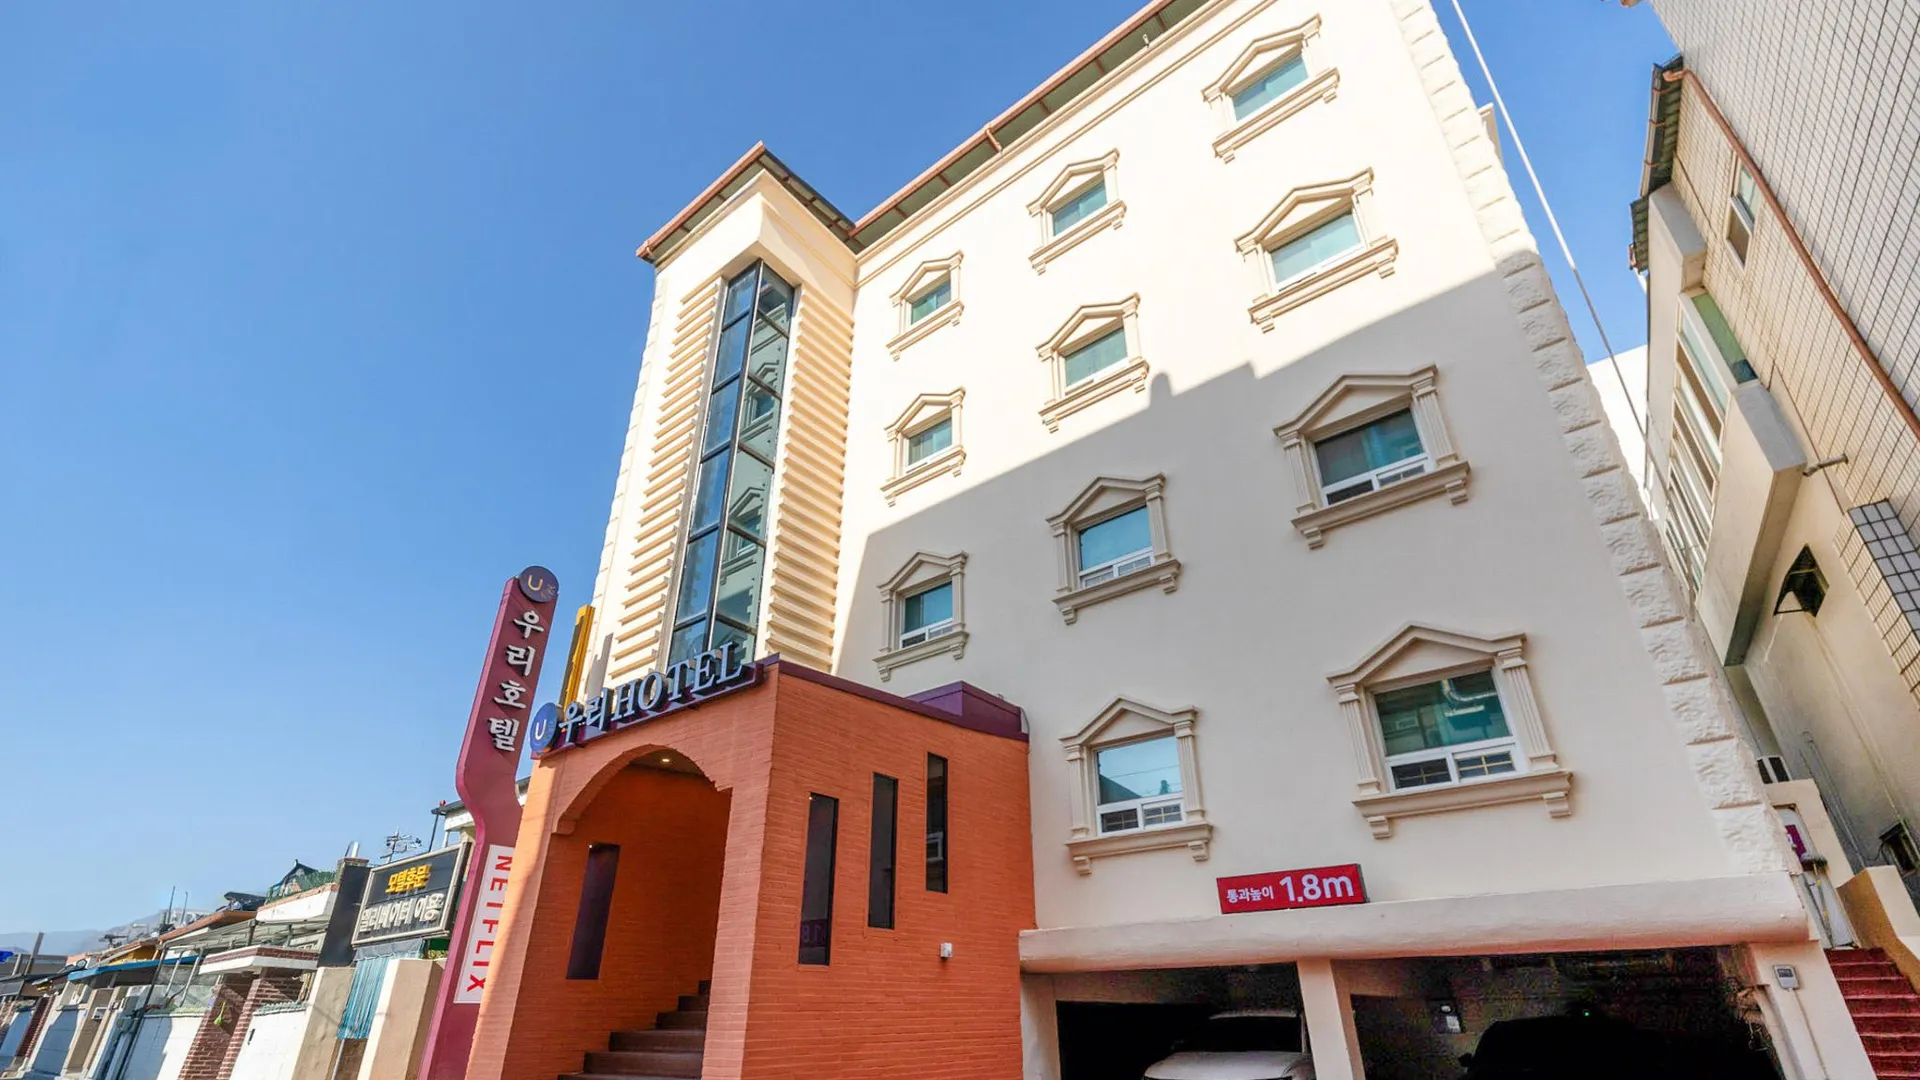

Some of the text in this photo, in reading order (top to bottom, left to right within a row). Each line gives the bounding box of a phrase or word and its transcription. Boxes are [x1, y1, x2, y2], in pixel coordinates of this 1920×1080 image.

[487, 610, 544, 752] 우리호텔
[559, 641, 744, 743] 우리 HOTEL
[414, 893, 445, 922] 이용
[1227, 874, 1354, 903] 통과높이 1.8m
